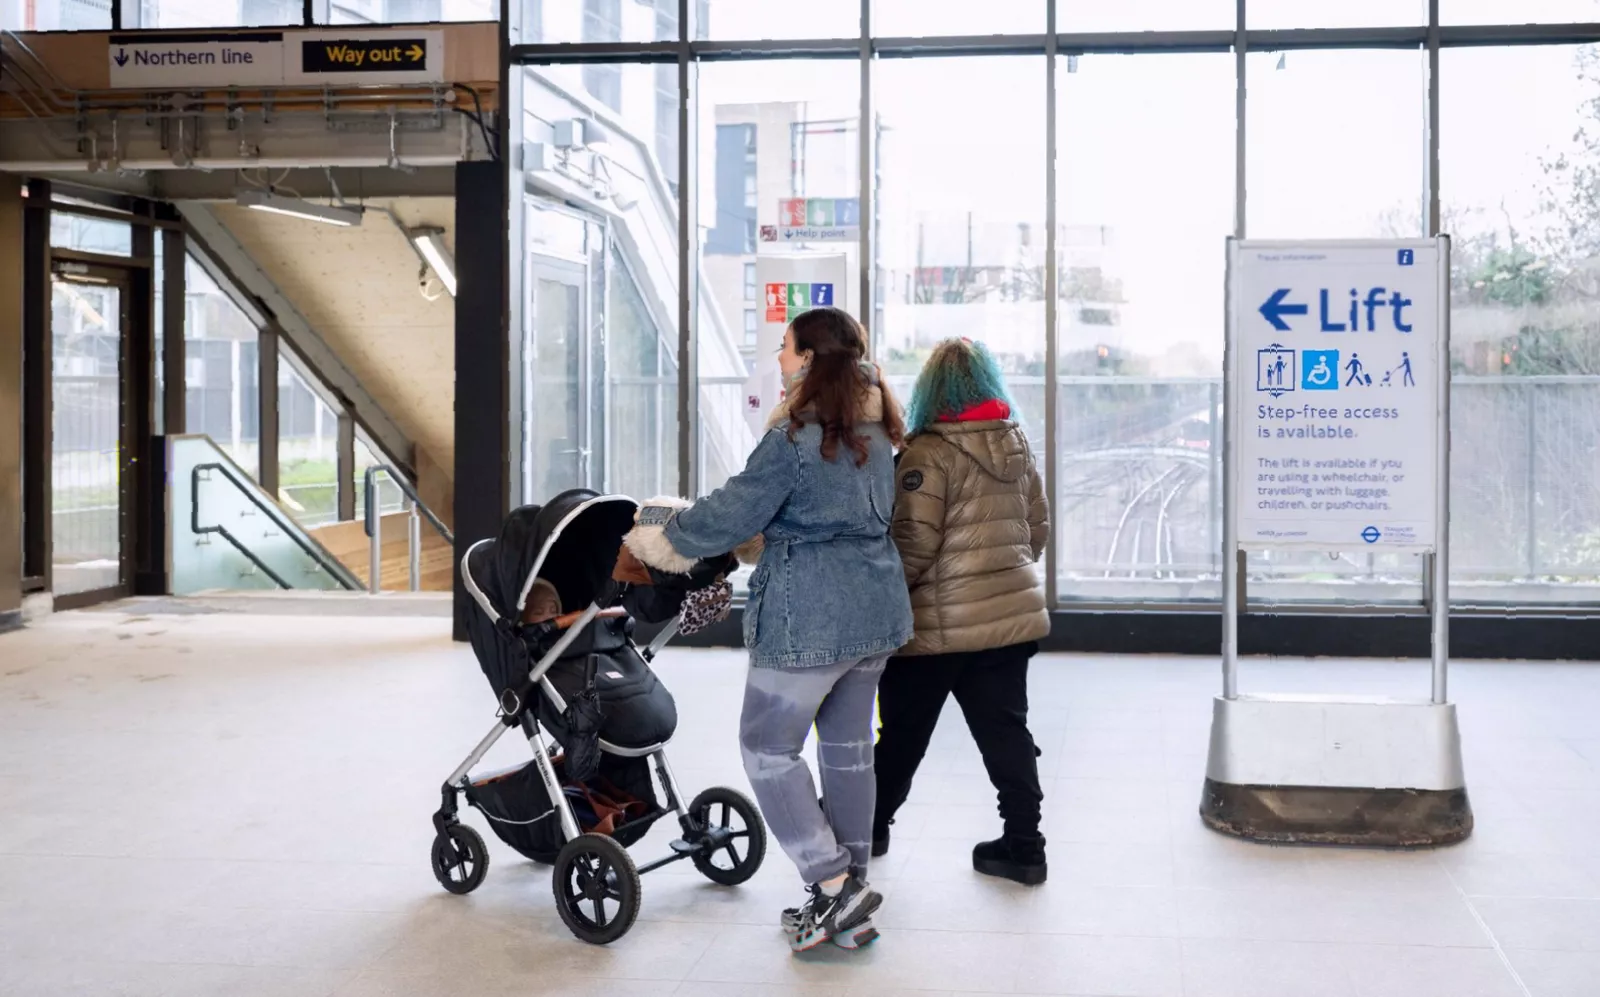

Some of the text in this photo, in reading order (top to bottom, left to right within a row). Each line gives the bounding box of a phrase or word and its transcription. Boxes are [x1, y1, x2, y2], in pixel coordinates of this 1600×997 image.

[134, 48, 253, 65] Northern line
[326, 45, 401, 66] Way out
[795, 228, 846, 238] Help point
[1319, 286, 1412, 333] Lift
[1258, 404, 1399, 421] Step-free access
[1258, 424, 1358, 438] is available.
[1257, 457, 1402, 470] The lift is available if you
[1257, 474, 1275, 482] are
[1278, 473, 1309, 484] using
[1312, 474, 1319, 482] a
[1258, 486, 1312, 498] travelling
[1316, 486, 1342, 496] with
[1310, 502, 1323, 510] or
